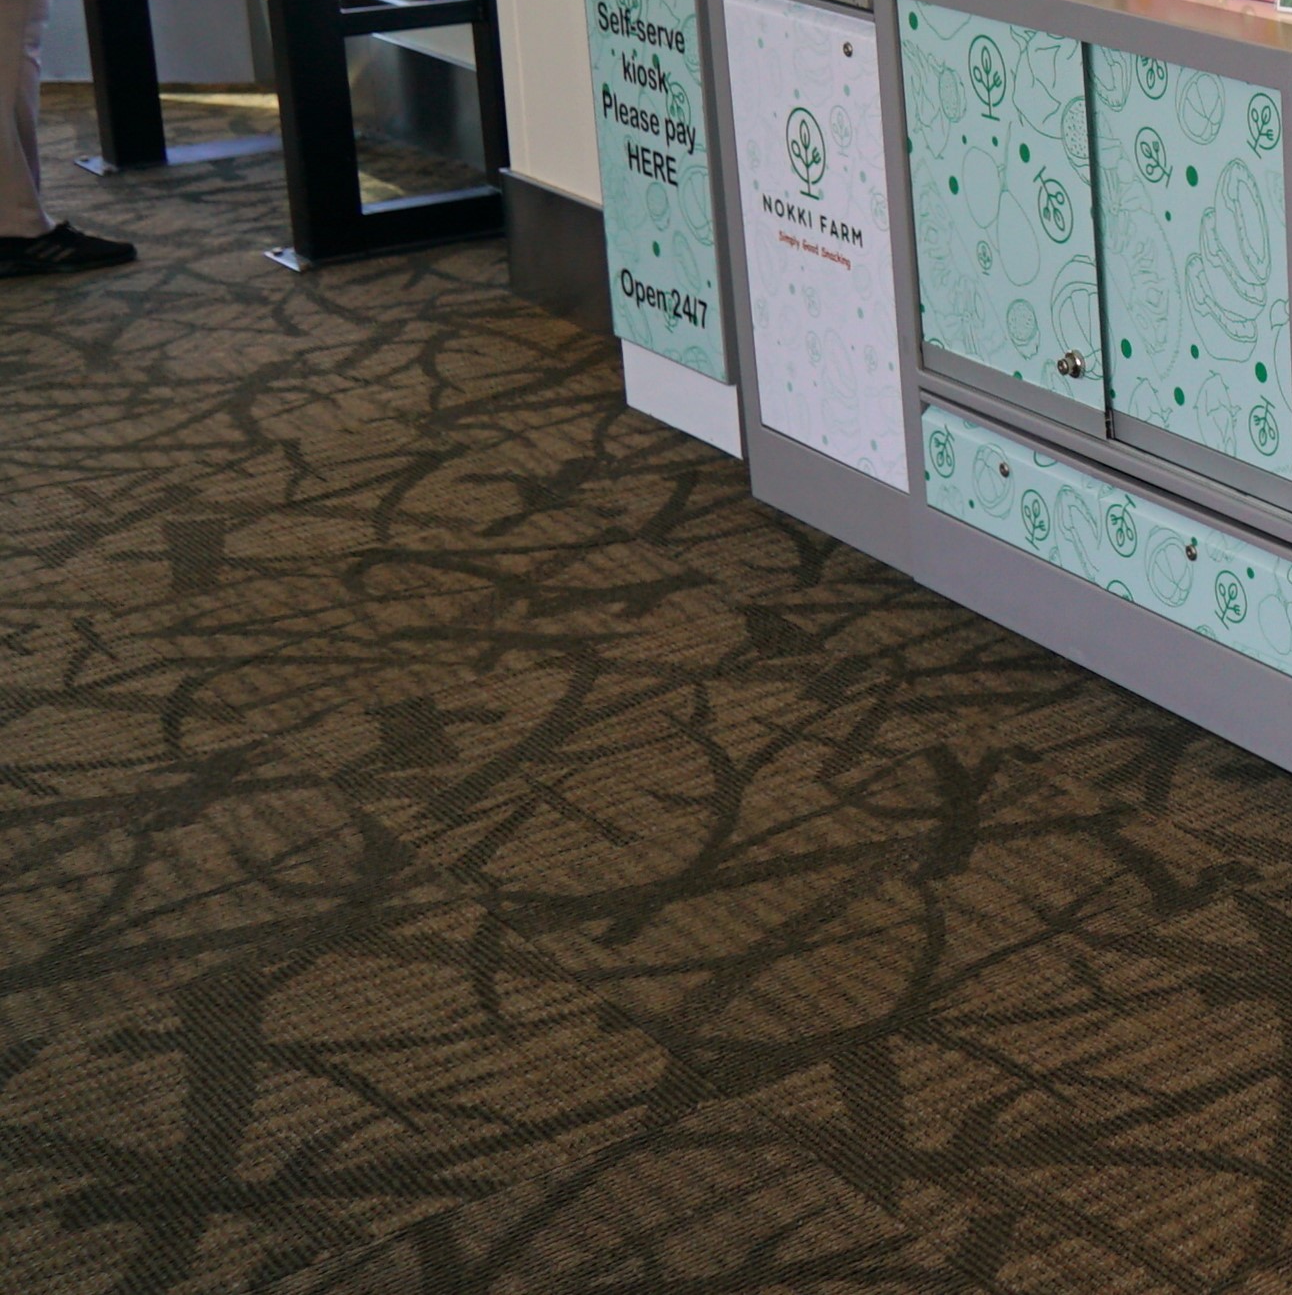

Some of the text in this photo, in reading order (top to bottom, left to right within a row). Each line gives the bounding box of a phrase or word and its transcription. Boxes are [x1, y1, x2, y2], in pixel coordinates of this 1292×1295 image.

[598, 2, 685, 55] Self-serve
[622, 52, 670, 93] kiosk
[602, 90, 696, 155] Please pay
[628, 141, 679, 186] HERE
[763, 193, 863, 248] NOKKI FARM
[621, 269, 708, 329] Open 24/7
